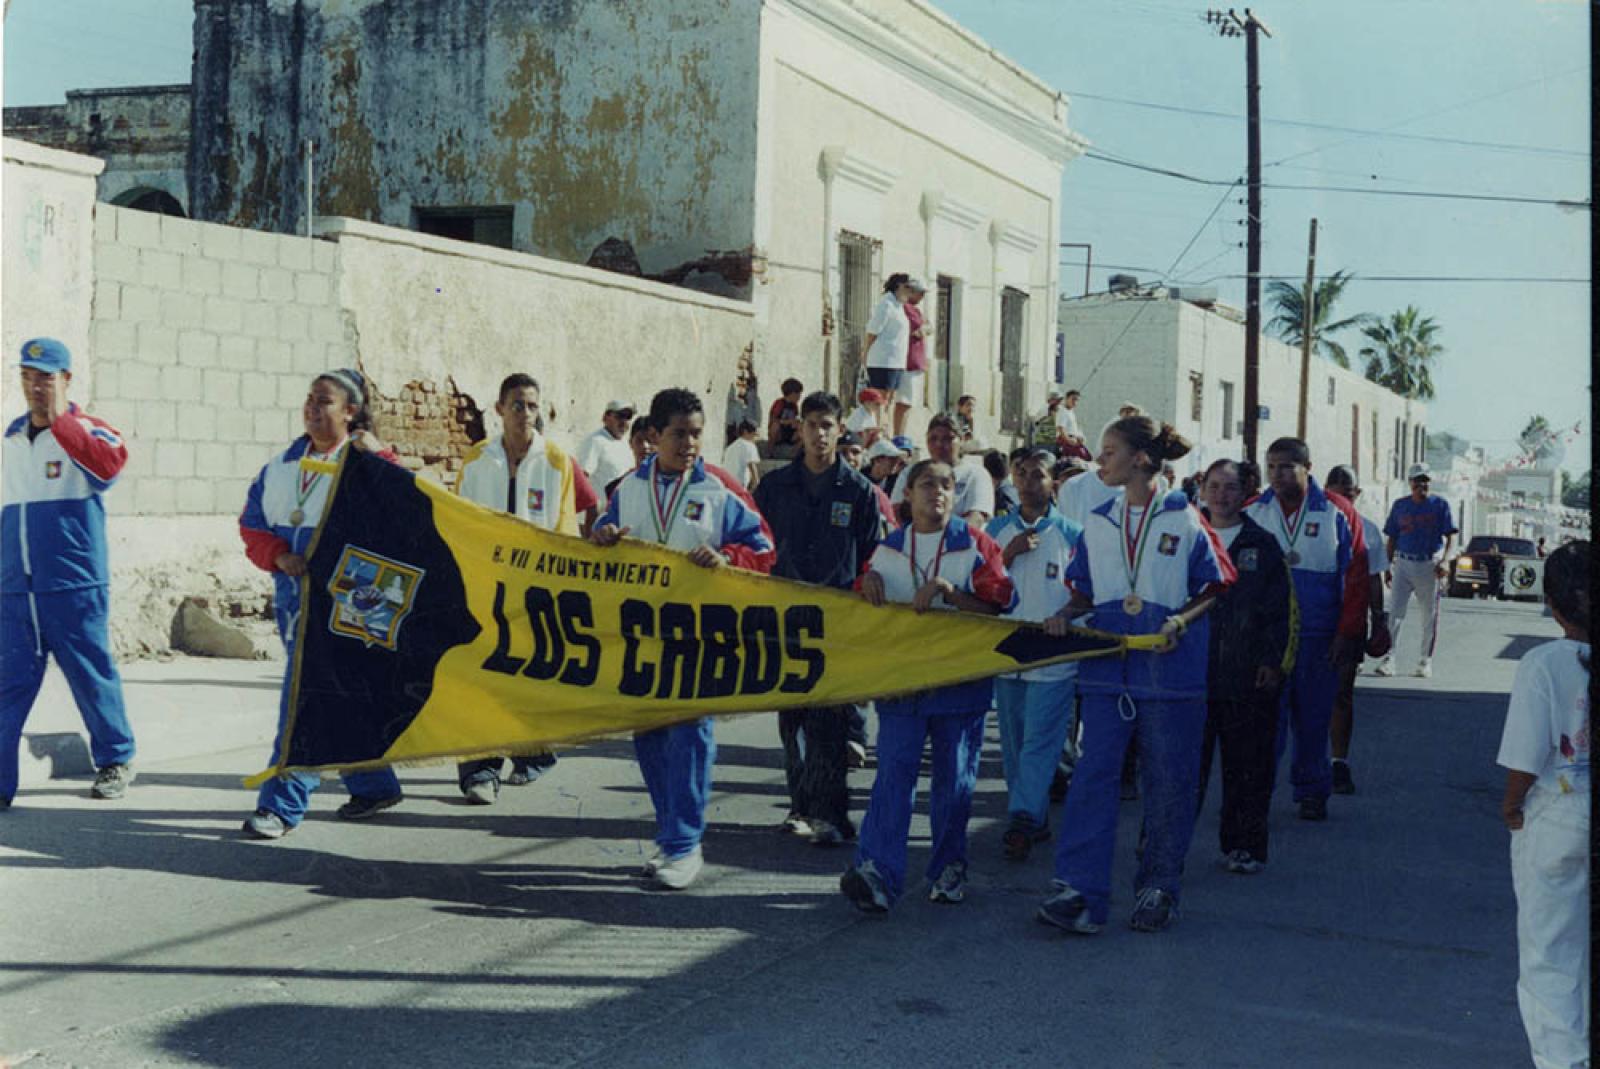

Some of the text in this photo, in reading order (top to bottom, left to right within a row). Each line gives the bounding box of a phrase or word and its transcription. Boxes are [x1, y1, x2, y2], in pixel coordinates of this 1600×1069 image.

[509, 548, 531, 570] VII
[535, 552, 672, 588] AYUNTAMIENTO
[482, 581, 825, 699] LOS CABOS
